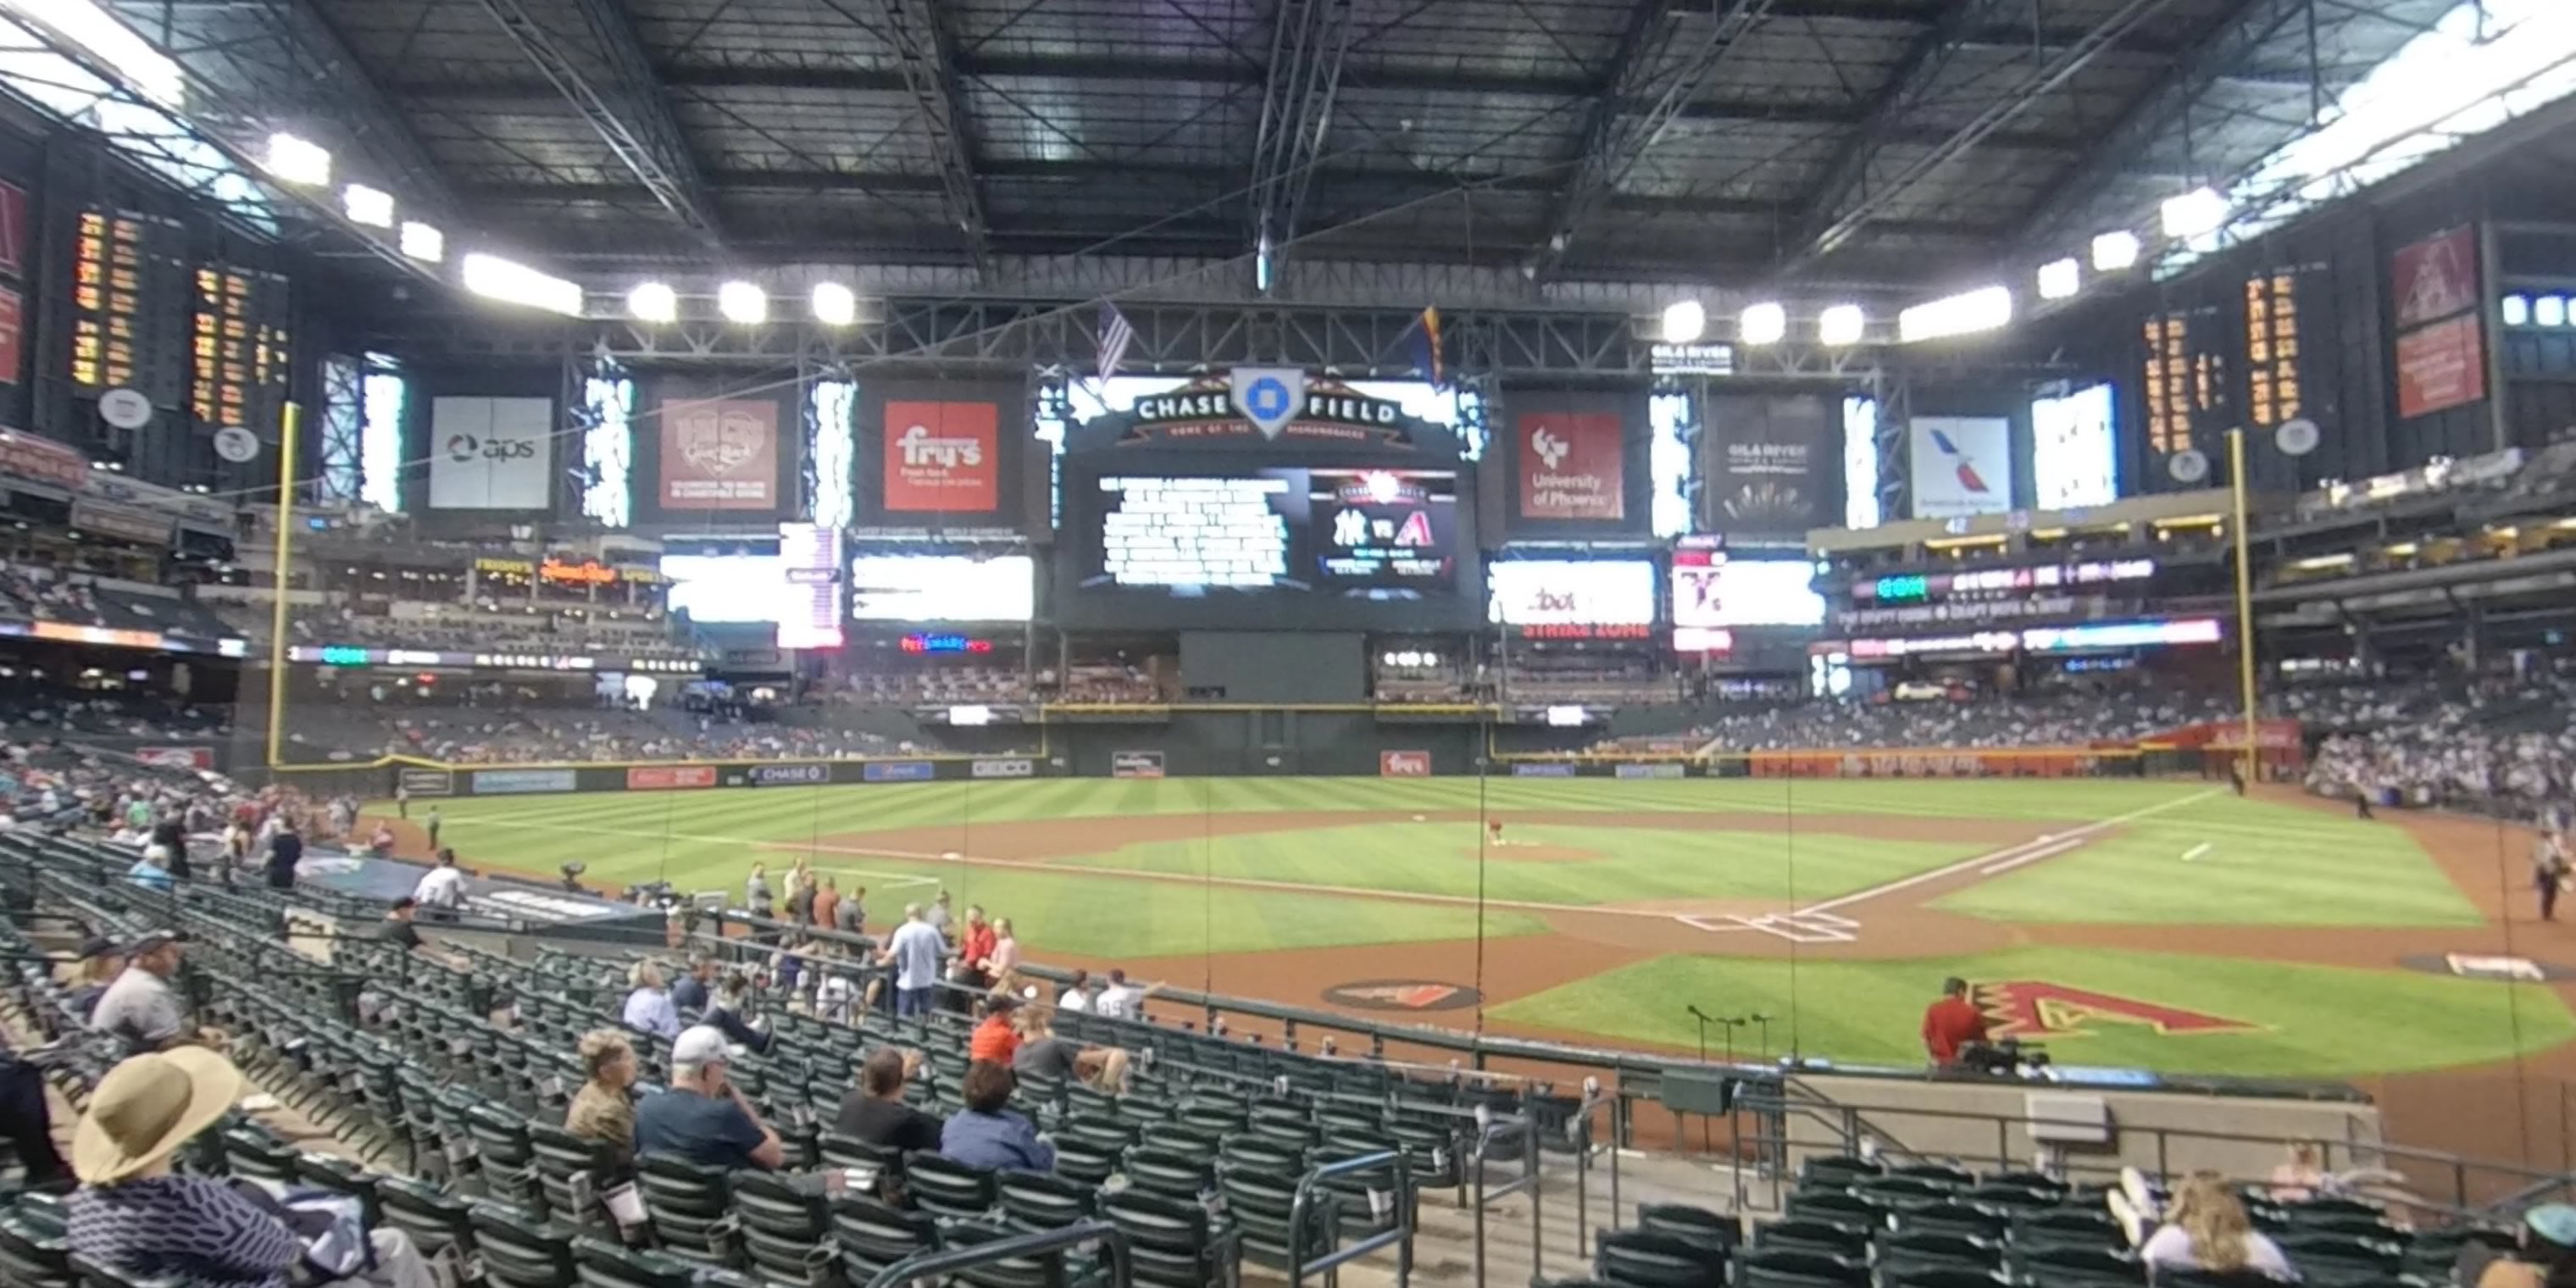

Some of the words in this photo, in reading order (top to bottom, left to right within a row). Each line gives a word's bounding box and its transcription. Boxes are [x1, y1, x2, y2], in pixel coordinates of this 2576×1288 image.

[1652, 345, 1685, 357] GILA
[1138, 394, 1228, 419] CHASE
[1310, 396, 1395, 423] FIELD
[483, 439, 535, 464] aps
[895, 424, 981, 467] fry's
[1532, 473, 1601, 493] University
[1533, 491, 1548, 506] of
[1550, 491, 1605, 507] Phoenix
[1524, 624, 1586, 638] STRIKE
[763, 767, 807, 780] CHASE
[973, 761, 1032, 776] GEICO
